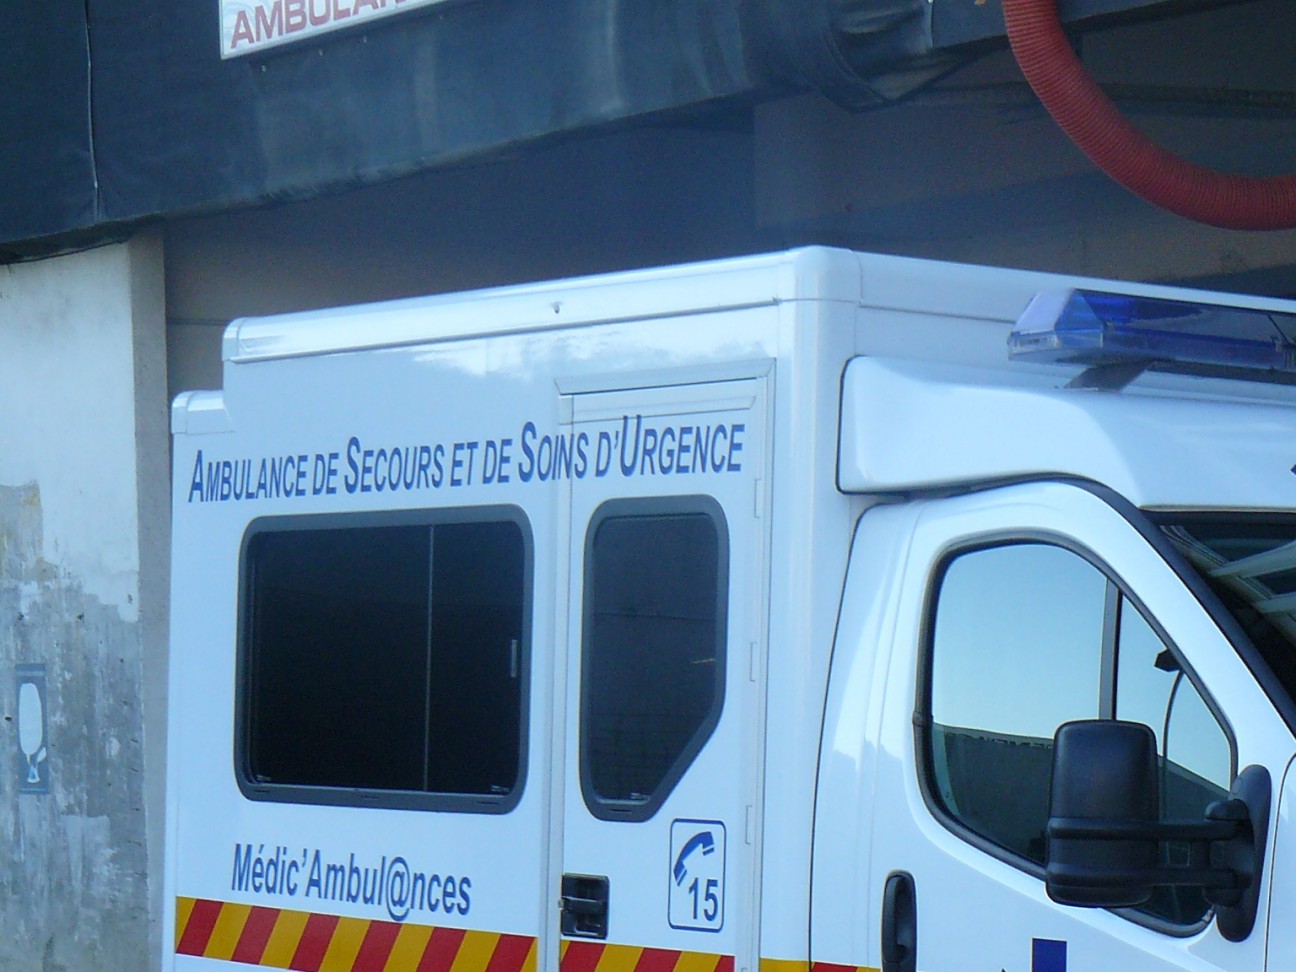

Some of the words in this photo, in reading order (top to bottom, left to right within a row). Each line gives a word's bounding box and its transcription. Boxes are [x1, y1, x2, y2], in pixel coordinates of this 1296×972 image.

[231, 0, 401, 49] AMBUL
[188, 449, 309, 503] AMBULANCE
[312, 452, 340, 495] DE
[344, 436, 446, 494] SECOURS
[450, 441, 479, 487] ET
[482, 438, 513, 484] DE
[518, 421, 590, 483] SOINS
[595, 414, 746, 478] D'URGENCE
[687, 876, 719, 922] 15
